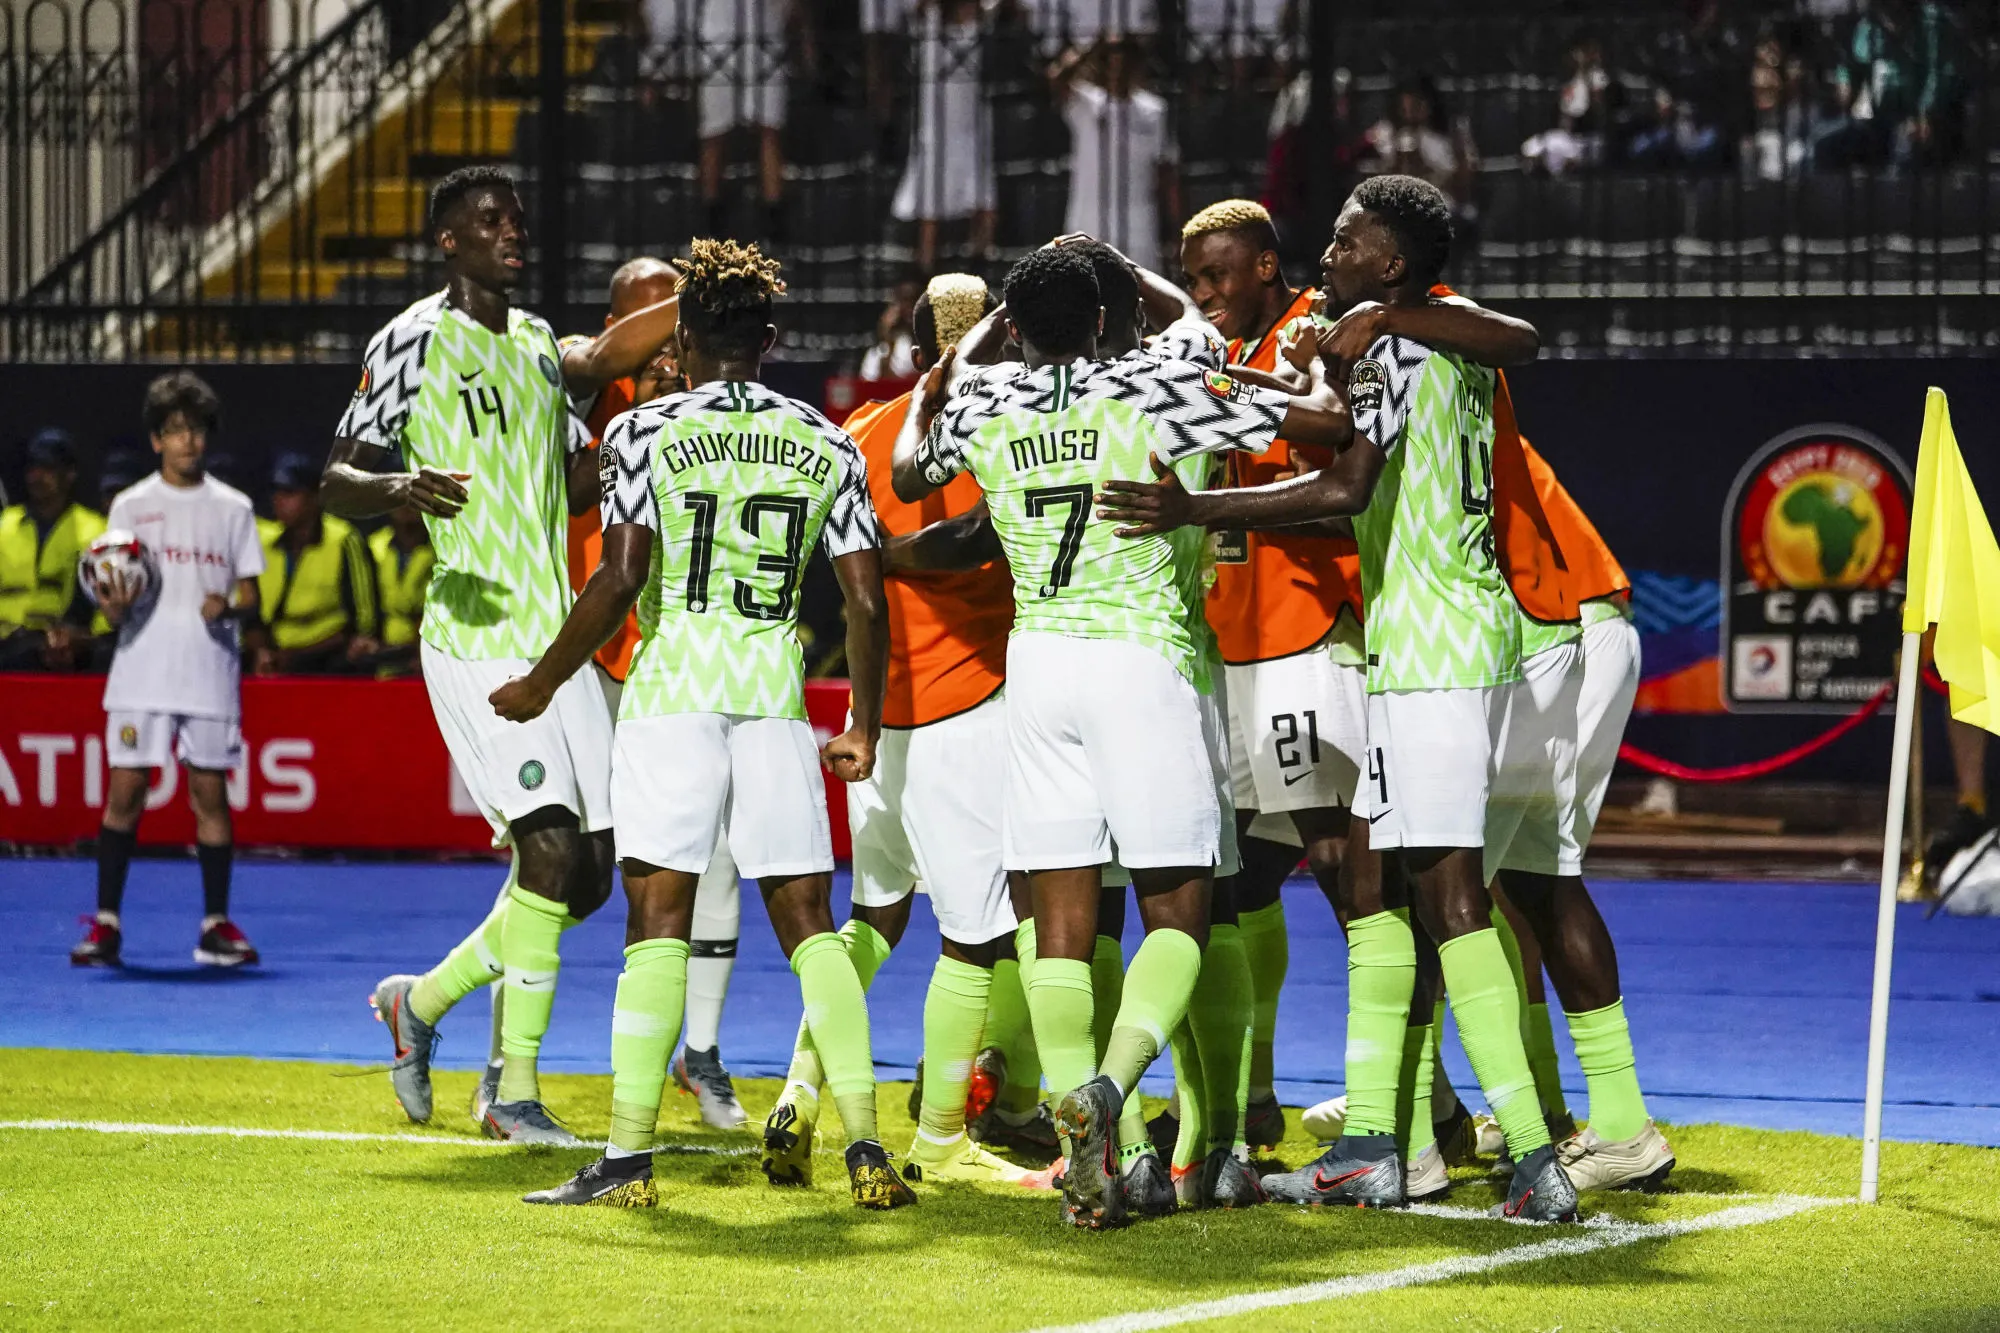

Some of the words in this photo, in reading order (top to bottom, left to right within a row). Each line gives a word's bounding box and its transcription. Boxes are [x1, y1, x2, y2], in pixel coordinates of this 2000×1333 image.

[458, 385, 507, 438] 14
[165, 546, 229, 568] TOTAL
[684, 491, 809, 621] 13
[1024, 483, 1094, 598] 7
[1764, 591, 1881, 625] CAF
[1271, 710, 1320, 768] 21
[1368, 747, 1388, 803] 4
